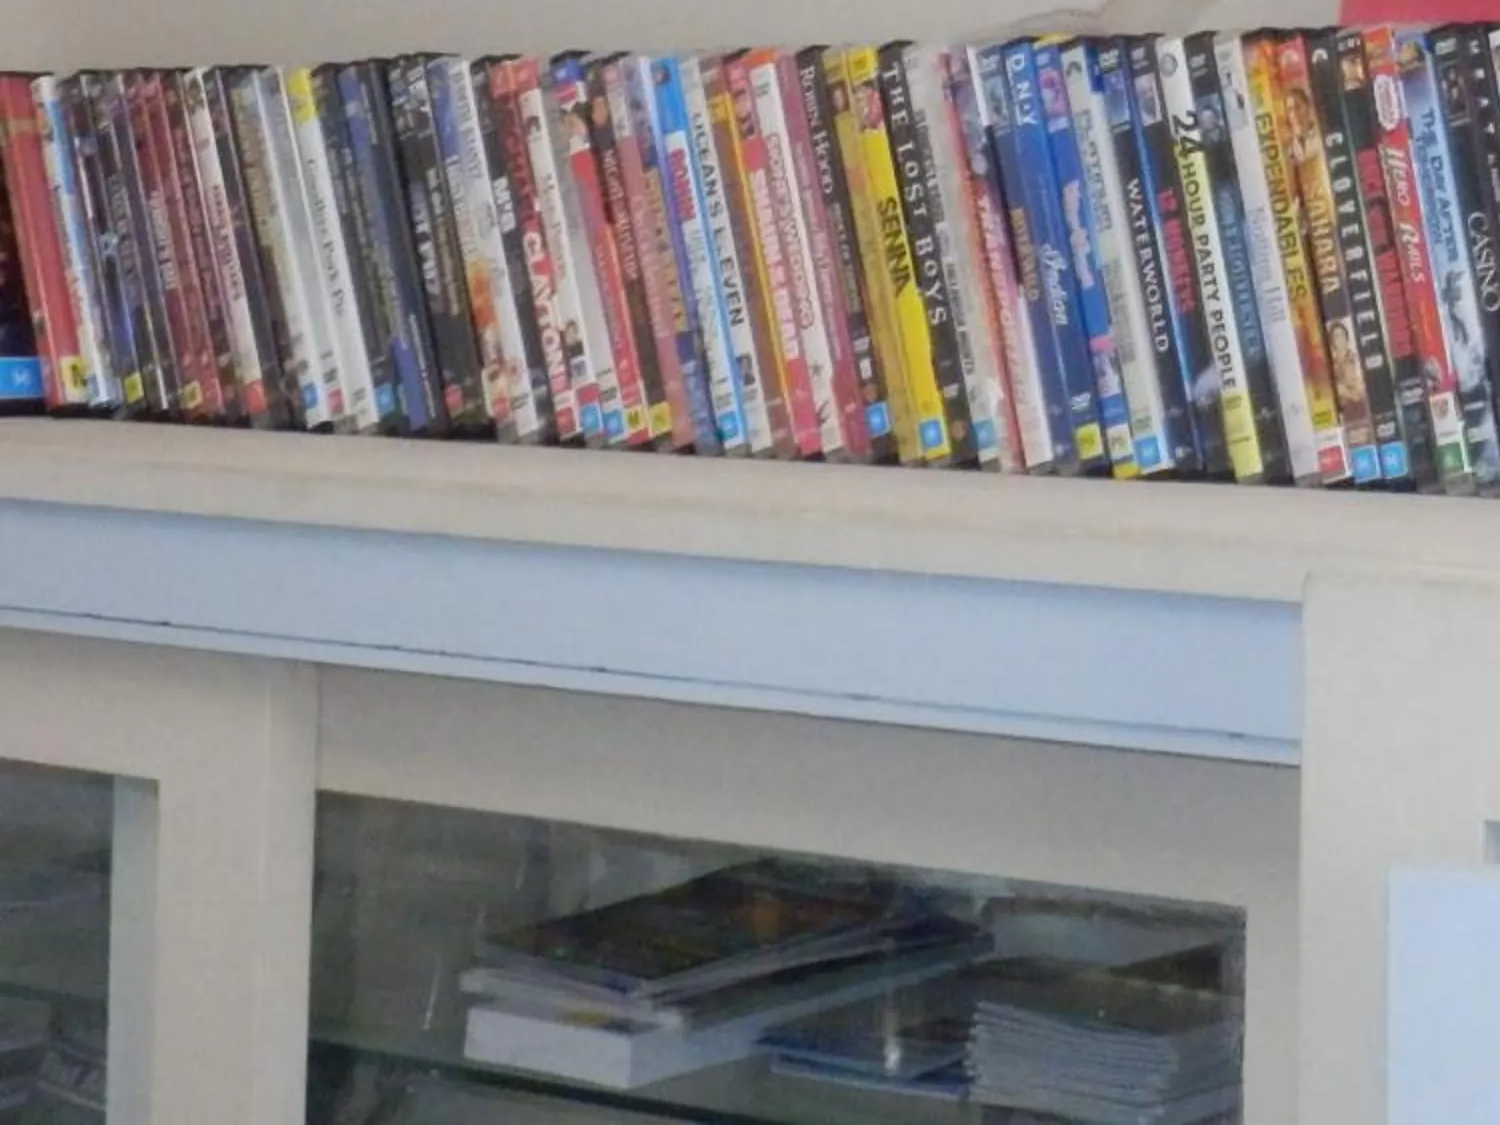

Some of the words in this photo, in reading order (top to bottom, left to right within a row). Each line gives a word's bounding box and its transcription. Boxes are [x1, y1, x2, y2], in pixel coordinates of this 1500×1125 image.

[877, 196, 913, 298] SENNA
[882, 60, 910, 125] THE
[897, 139, 925, 218] LOST
[916, 234, 950, 326] BOYS
[1126, 177, 1169, 352] WATERWORLD
[1196, 233, 1220, 301] PARTY
[1324, 130, 1383, 371] CLOVERFIELD
